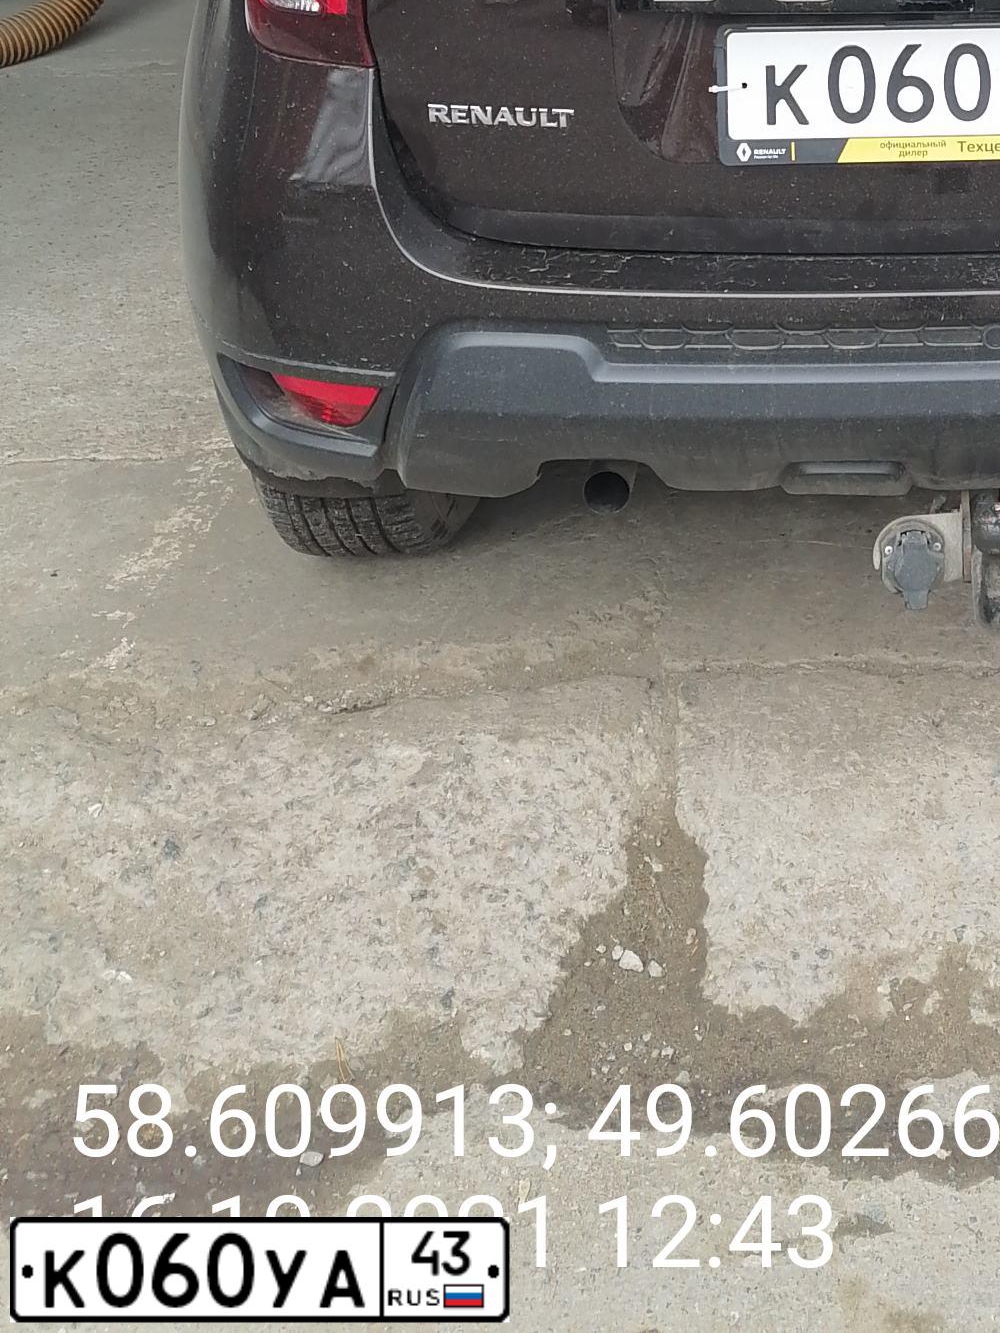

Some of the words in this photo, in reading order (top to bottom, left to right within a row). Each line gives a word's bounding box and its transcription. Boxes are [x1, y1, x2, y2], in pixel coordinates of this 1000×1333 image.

[427, 103, 575, 128] RENAULT
[880, 139, 947, 150] официальный
[899, 150, 928, 158] дилер
